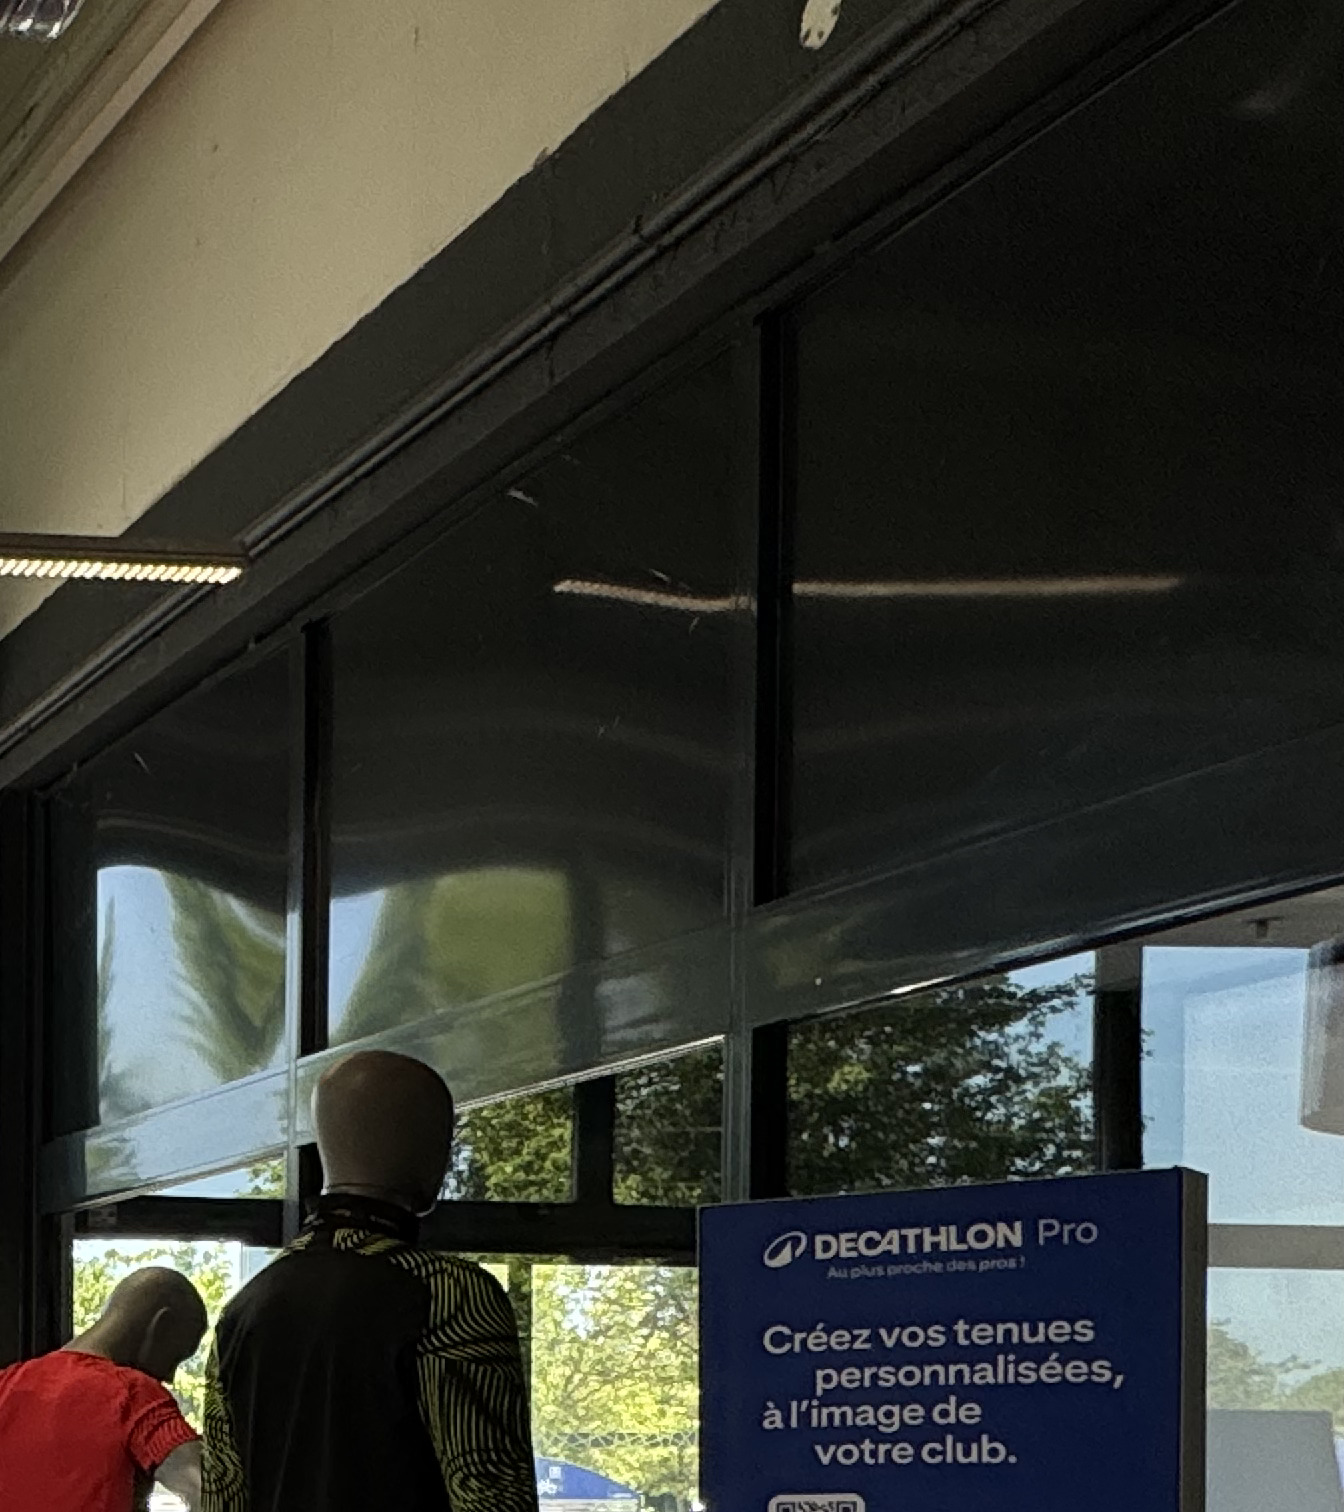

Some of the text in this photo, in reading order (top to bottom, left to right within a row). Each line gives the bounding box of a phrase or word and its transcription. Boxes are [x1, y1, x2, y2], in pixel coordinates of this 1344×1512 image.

[814, 1217, 1098, 1260] DECATHLON Pro
[827, 1264, 848, 1280] Au
[850, 1262, 885, 1281] plus
[887, 1260, 944, 1279] proche
[946, 1257, 976, 1273] des
[978, 1256, 1017, 1274] pros
[762, 1318, 1095, 1355] Créez vos tenues
[815, 1352, 1125, 1396] personnalisées,
[762, 1395, 983, 1433] à l'image de
[815, 1434, 1017, 1465] votre club.
